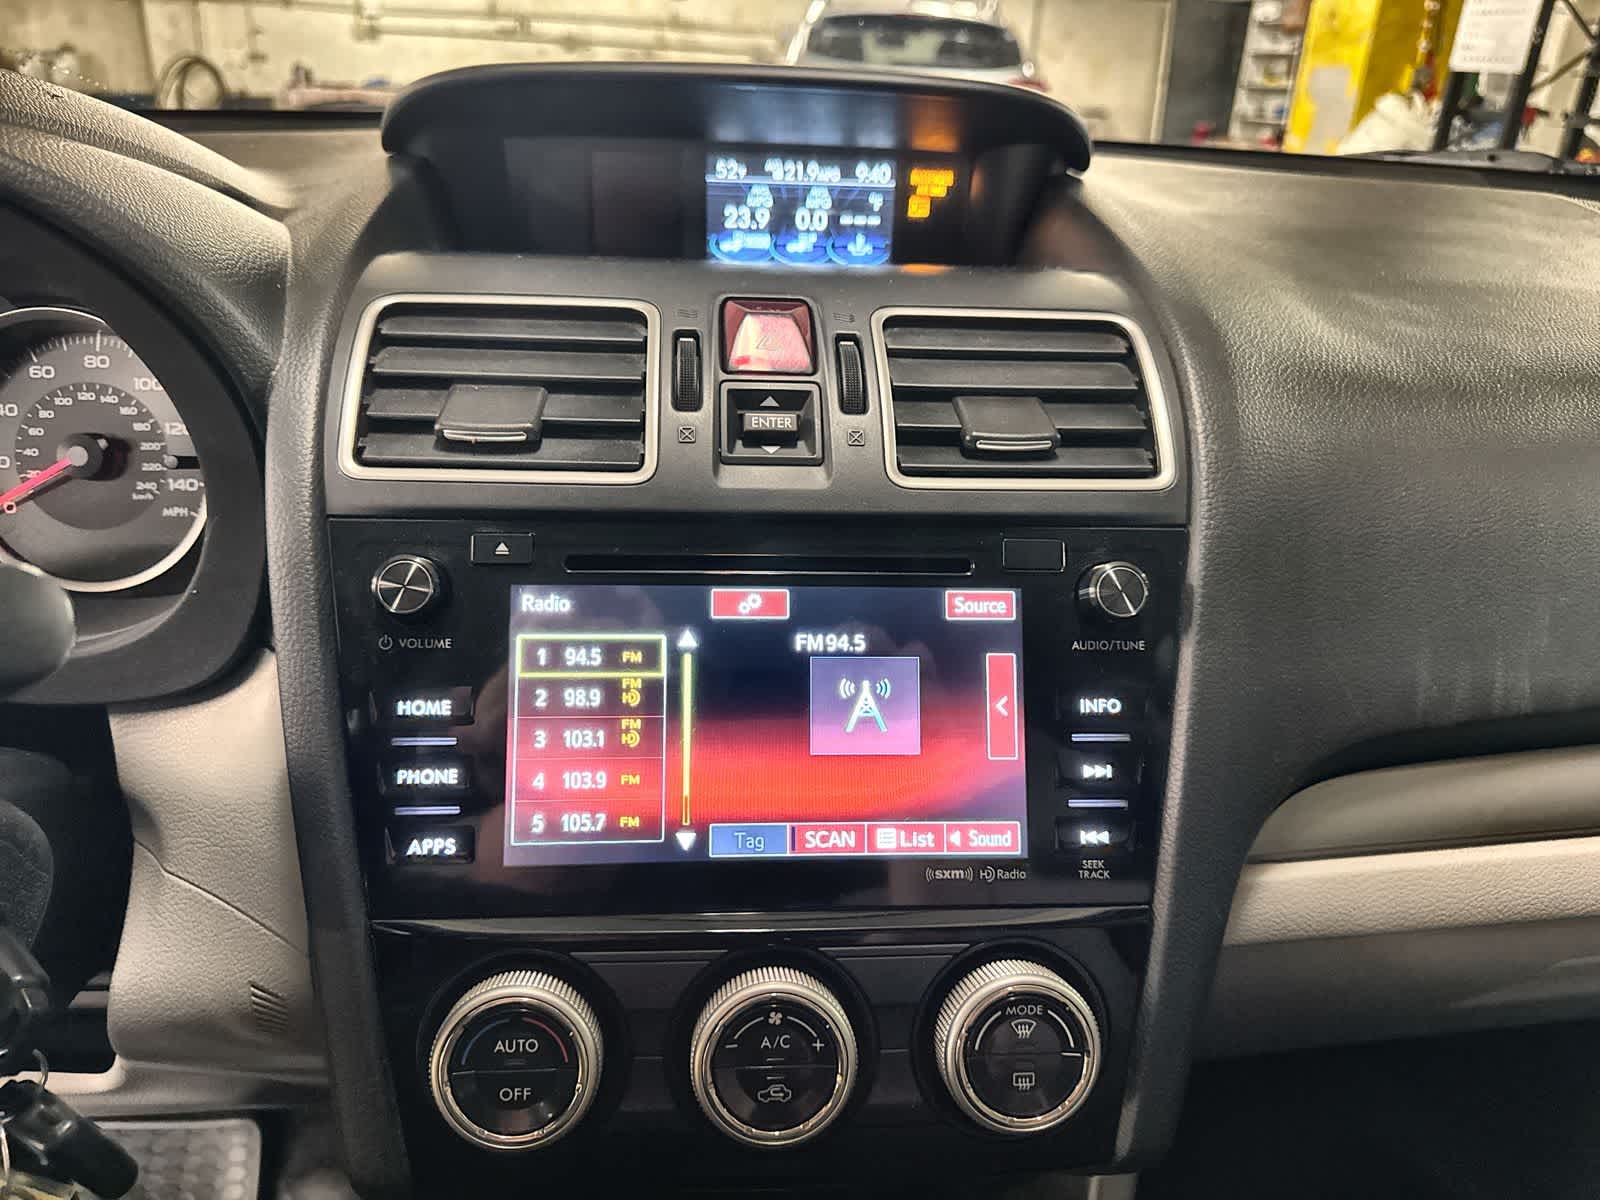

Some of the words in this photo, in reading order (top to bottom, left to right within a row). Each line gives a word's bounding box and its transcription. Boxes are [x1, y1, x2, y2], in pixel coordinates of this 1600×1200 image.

[723, 204, 770, 229] 23.9
[795, 207, 828, 231] 0.0
[84, 356, 110, 368] 80
[29, 366, 55, 378] 60
[133, 378, 164, 391] 100
[54, 397, 73, 406] 100
[77, 392, 95, 401] 120
[101, 395, 119, 404] 140
[752, 417, 792, 428] ENTER
[28, 427, 44, 436] 60
[23, 448, 39, 456] 40
[168, 478, 199, 491] 140
[162, 507, 188, 517] MPH
[521, 594, 571, 612] Radio
[954, 597, 1007, 614] Source
[399, 638, 452, 650] VOLUME
[1072, 639, 1145, 651] AUDIO/TUNE
[537, 648, 546, 665] 1
[565, 648, 602, 666] 94.5
[622, 651, 642, 663] FM
[622, 678, 642, 689] FM
[535, 689, 547, 706] 2
[564, 689, 601, 706] 98.9
[397, 700, 451, 716] HOME
[1080, 698, 1122, 714] INFO
[621, 719, 641, 730] FM
[534, 731, 546, 748] 3
[563, 730, 605, 748] 103.1
[397, 769, 458, 785] PHONE
[532, 772, 545, 789] 4
[562, 771, 606, 789] 103.9
[620, 775, 640, 785] FM
[531, 815, 544, 833] 5
[561, 814, 606, 833] 105.7
[619, 816, 640, 827] FM
[734, 832, 765, 851] Tag
[805, 830, 855, 848] SCAN
[900, 829, 935, 848] List
[969, 829, 1011, 847] Sound
[407, 838, 457, 855] APPS
[1082, 860, 1105, 869] SEEK
[997, 868, 1026, 880] Radio
[1078, 870, 1110, 880] TRACK
[1005, 1004, 1044, 1016] MODE
[494, 1039, 539, 1053] AUTO
[760, 1034, 791, 1049] A/C
[499, 1087, 532, 1102] OFF
